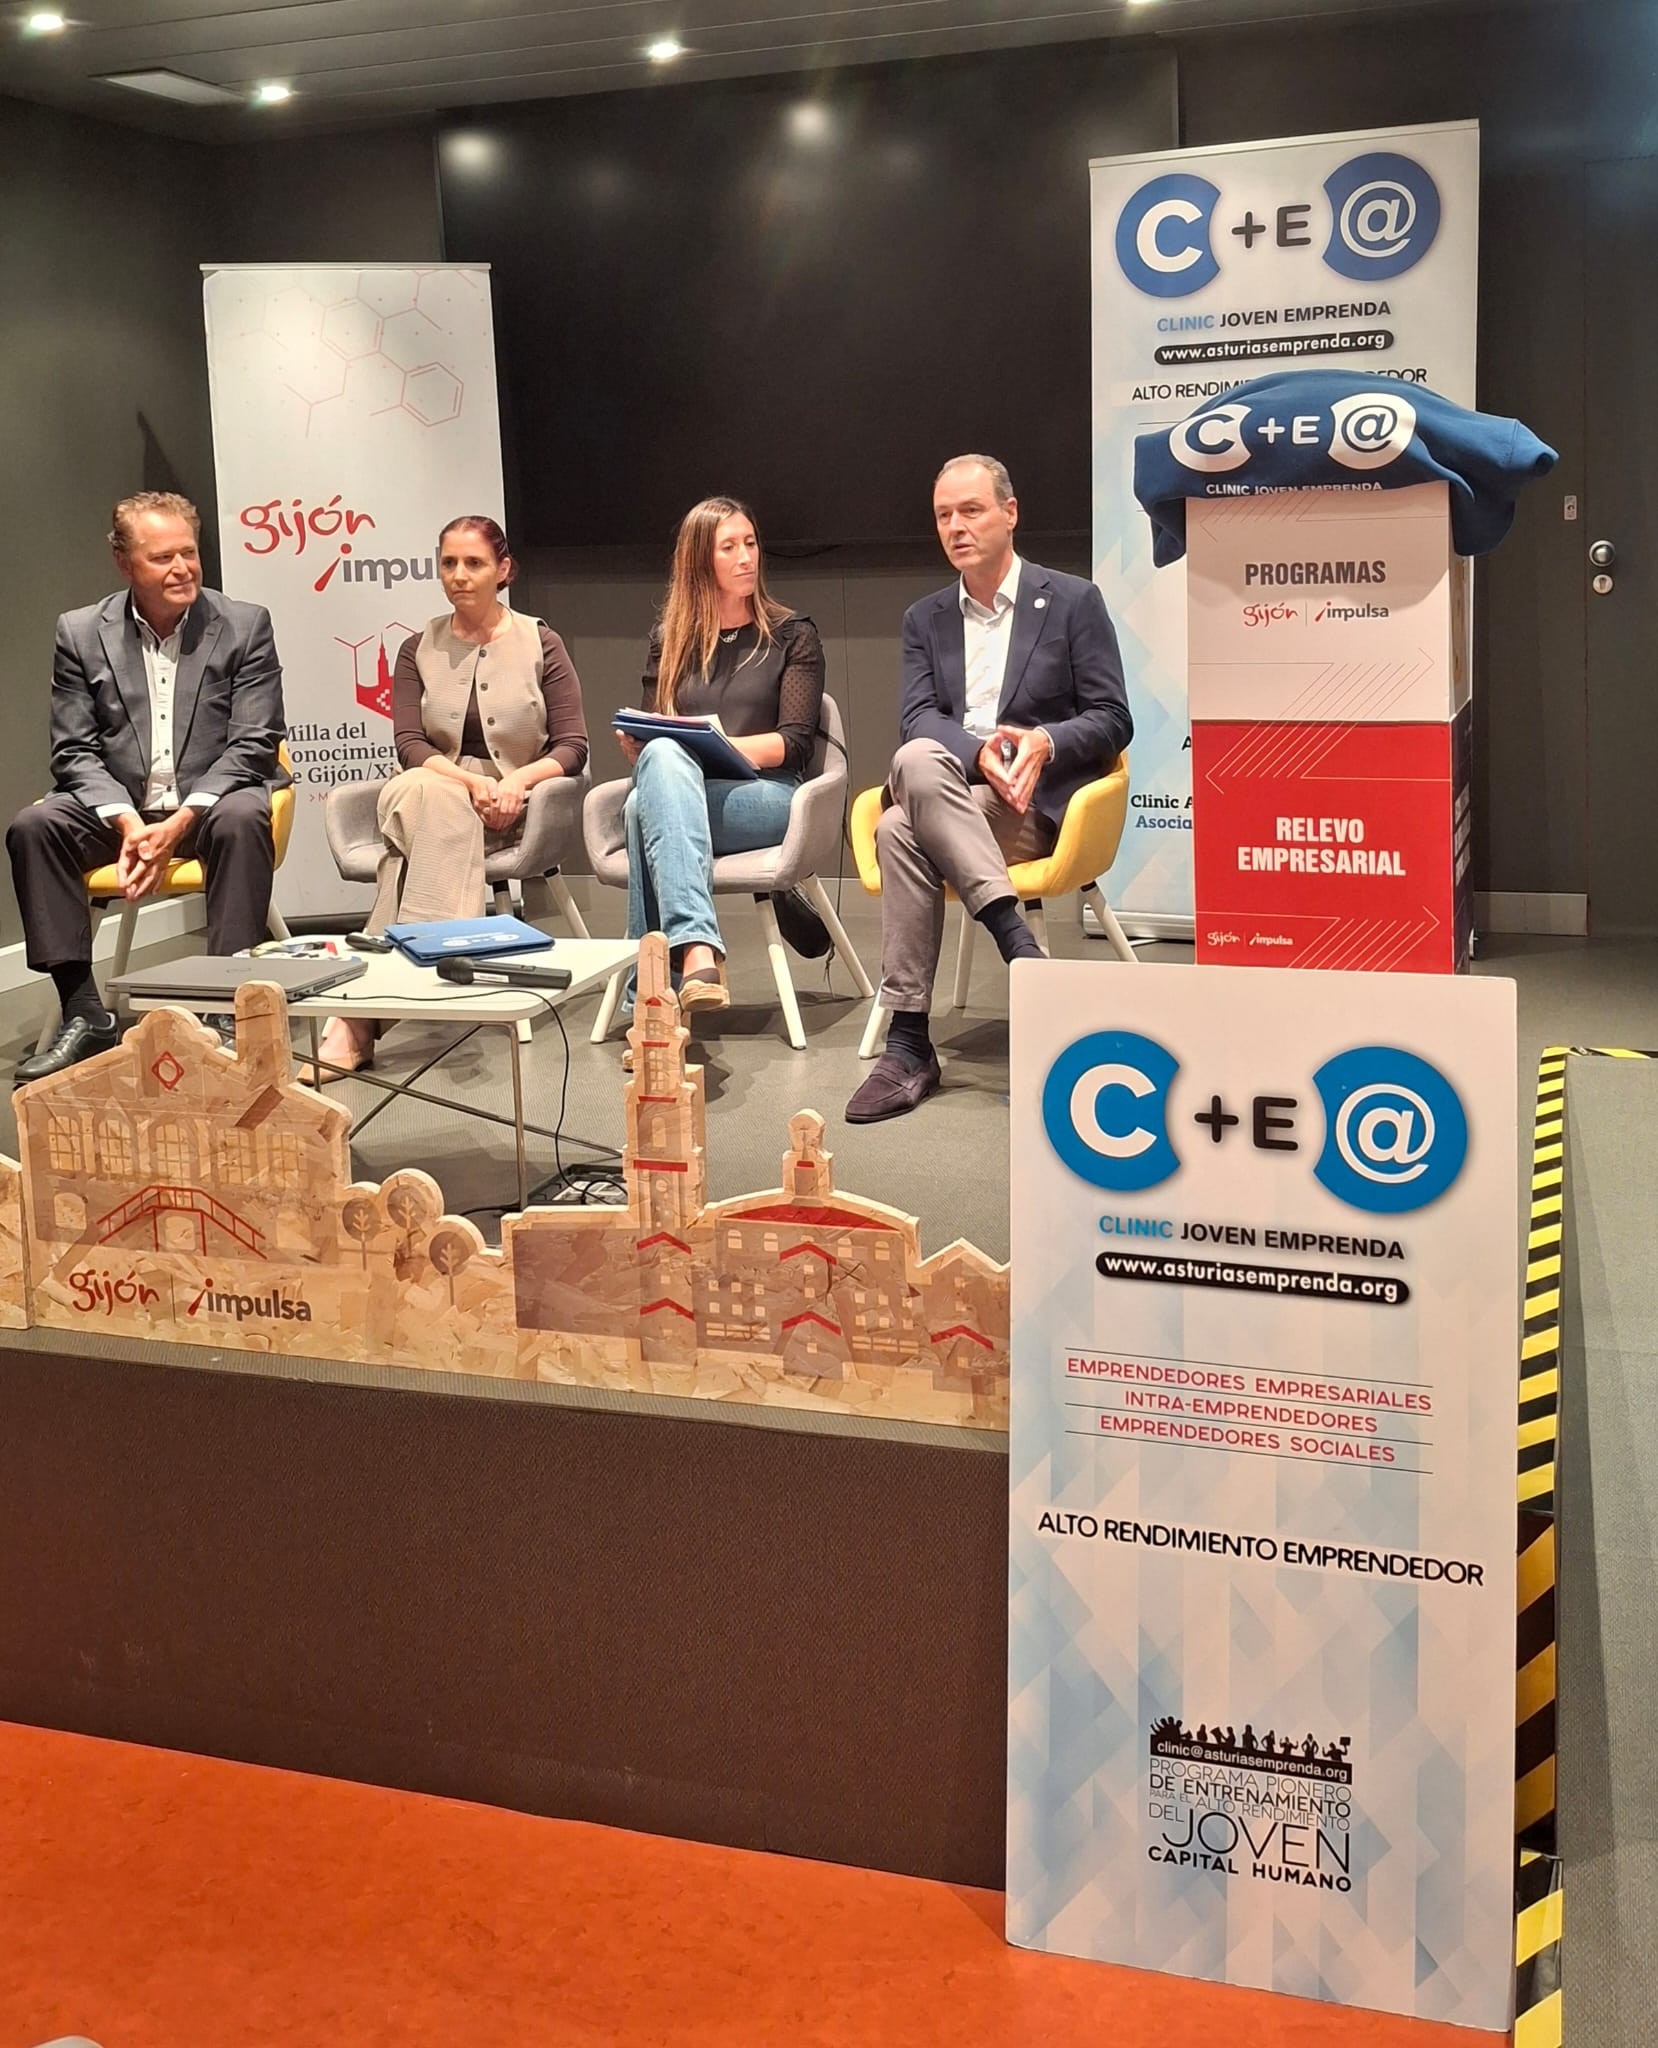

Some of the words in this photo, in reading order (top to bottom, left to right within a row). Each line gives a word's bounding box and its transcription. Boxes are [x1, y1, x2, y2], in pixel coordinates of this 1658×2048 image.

[1157, 315, 1215, 332] CLINIC
[1219, 309, 1278, 328] JOVEN
[1284, 301, 1391, 324] EMPRENDA
[1161, 332, 1385, 361] www.asturiasemprenda.org
[1132, 384, 1171, 400] ALTO
[1205, 483, 1250, 496] CLINIC
[240, 494, 376, 555] gijón
[314, 543, 441, 592] impul
[1245, 560, 1386, 586] PROGRAMAS
[1243, 602, 1298, 627] gijón
[1315, 601, 1389, 622] impulsa
[336, 721, 367, 739] del
[1130, 794, 1179, 808] Clinic
[1136, 815, 1192, 829] Asocia
[1276, 817, 1364, 843] RELEVO
[1237, 846, 1406, 876] EMPRESARIAL
[1249, 932, 1293, 946] impulsa
[1099, 1216, 1173, 1239] CLINIC
[1180, 1222, 1256, 1247] JOVEN
[1265, 1231, 1405, 1260] EMPRENDA
[69, 1269, 160, 1316] gijón
[187, 1278, 312, 1321] impulsa
[1105, 1256, 1398, 1302] www.asturiasemprenda.org
[1067, 1358, 1245, 1391] EMPRENDEDORES
[1255, 1378, 1432, 1411] EMPRESARIALES
[1125, 1391, 1377, 1432] INTRA-EMPRENDEDORES
[1100, 1415, 1280, 1449] EMPRENDEDORES
[1290, 1437, 1395, 1462] SOCIALES
[1038, 1511, 1098, 1538] ALTO
[1103, 1520, 1277, 1561] RENDIMIENTO
[1283, 1542, 1484, 1587] EMPRENDEDOR
[1150, 1758, 1259, 1790] PROGRAMA
[1266, 1776, 1352, 1802] PIONERO
[1157, 1741, 1347, 1782] clinic@asturiasemprenda.org
[1149, 1789, 1176, 1800] PARA
[1180, 1794, 1191, 1803] EL
[1195, 1796, 1235, 1814] ALTO
[1241, 1802, 1350, 1830] RENDIMIENTO
[1149, 1802, 1184, 1822] DEL
[1150, 1774, 1175, 1791] DE
[1184, 1778, 1351, 1818] ENTRENAMIENTO
[1162, 1808, 1350, 1874] JOVEN
[1148, 1846, 1239, 1874] CAPITAL
[1252, 1862, 1351, 1892] HUMANO
